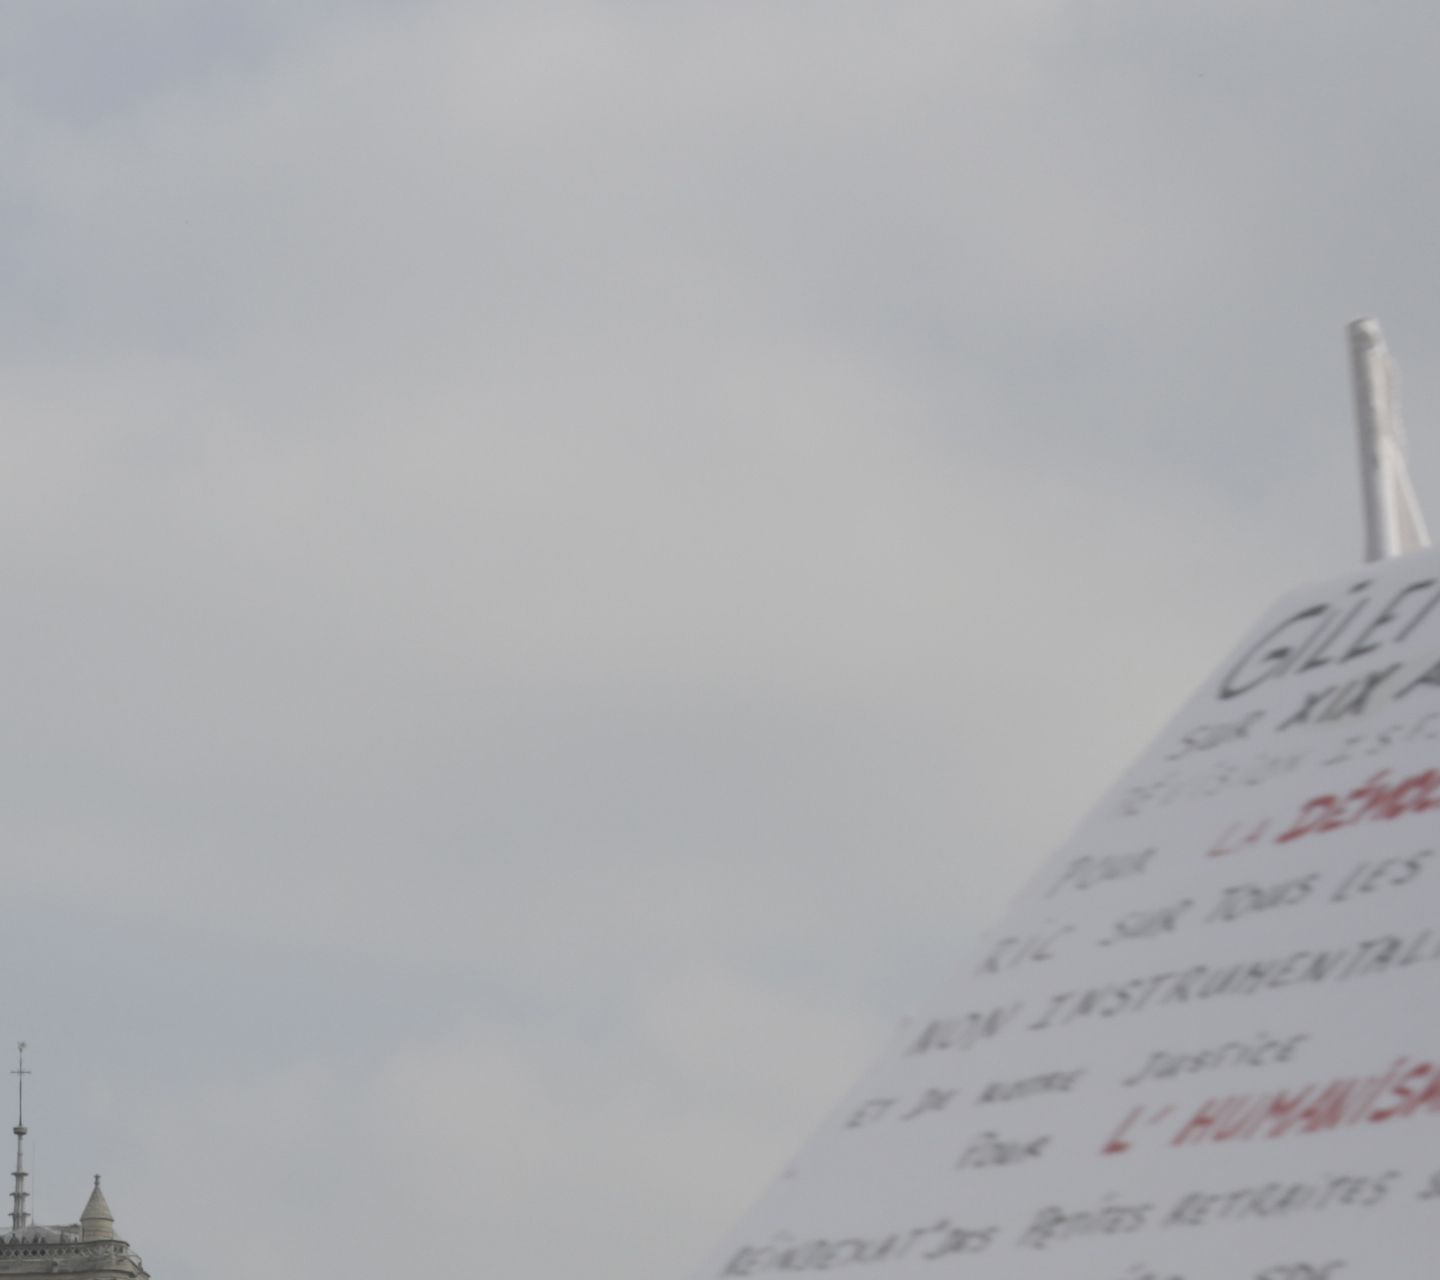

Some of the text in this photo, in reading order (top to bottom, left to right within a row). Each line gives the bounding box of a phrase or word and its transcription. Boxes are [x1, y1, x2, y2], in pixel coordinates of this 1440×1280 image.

[1165, 710, 1267, 762] SUR
[1203, 818, 1274, 860] LA
[1096, 897, 1196, 948] SUR
[1202, 872, 1323, 926] TOUS
[1329, 850, 1436, 903] LES
[903, 1001, 1024, 1058] NON
